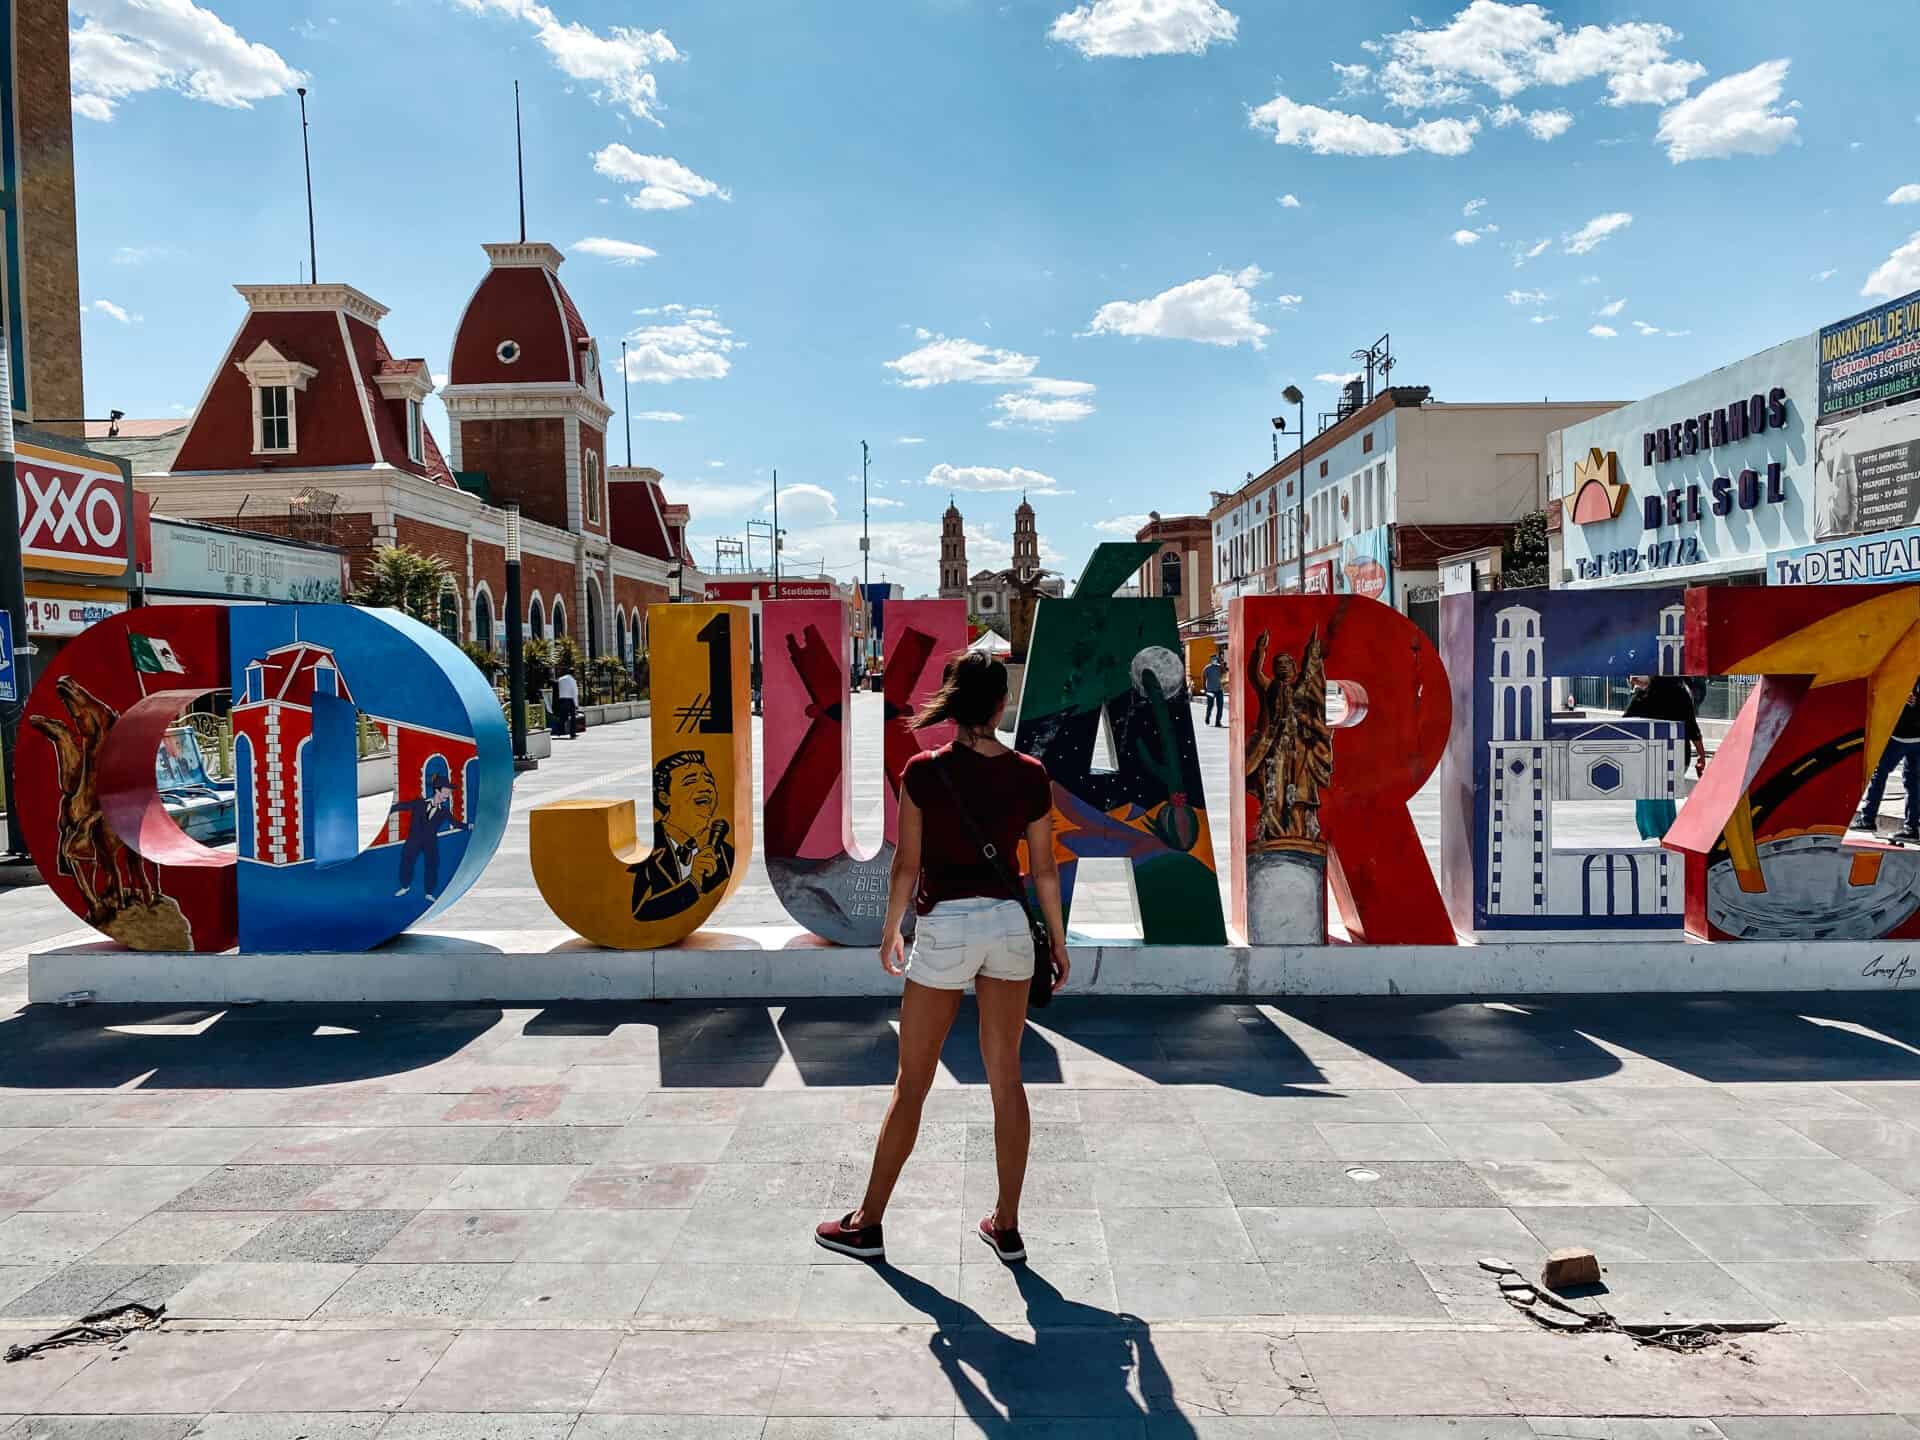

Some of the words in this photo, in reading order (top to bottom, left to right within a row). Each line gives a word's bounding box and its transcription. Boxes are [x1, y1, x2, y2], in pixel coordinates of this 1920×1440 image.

[1823, 317, 1883, 363] MANANTIAL
[1888, 308, 1903, 340] DE
[1832, 356, 1870, 380] LECTURA
[1870, 352, 1884, 367] DE
[1833, 370, 1877, 392] PRODUCTOS
[1824, 395, 1842, 413] CALLE
[1855, 391, 1865, 404] DE
[1866, 377, 1910, 400] SEPTIEMBRE
[1643, 387, 1786, 466] PRESTAMOS
[16, 470, 121, 548] XXO
[1643, 485, 1701, 530] DEL
[1711, 463, 1786, 517] SOL
[1804, 536, 1920, 584] DENTAL
[781, 586, 829, 597] Scotiabank
[673, 612, 733, 734] #1
